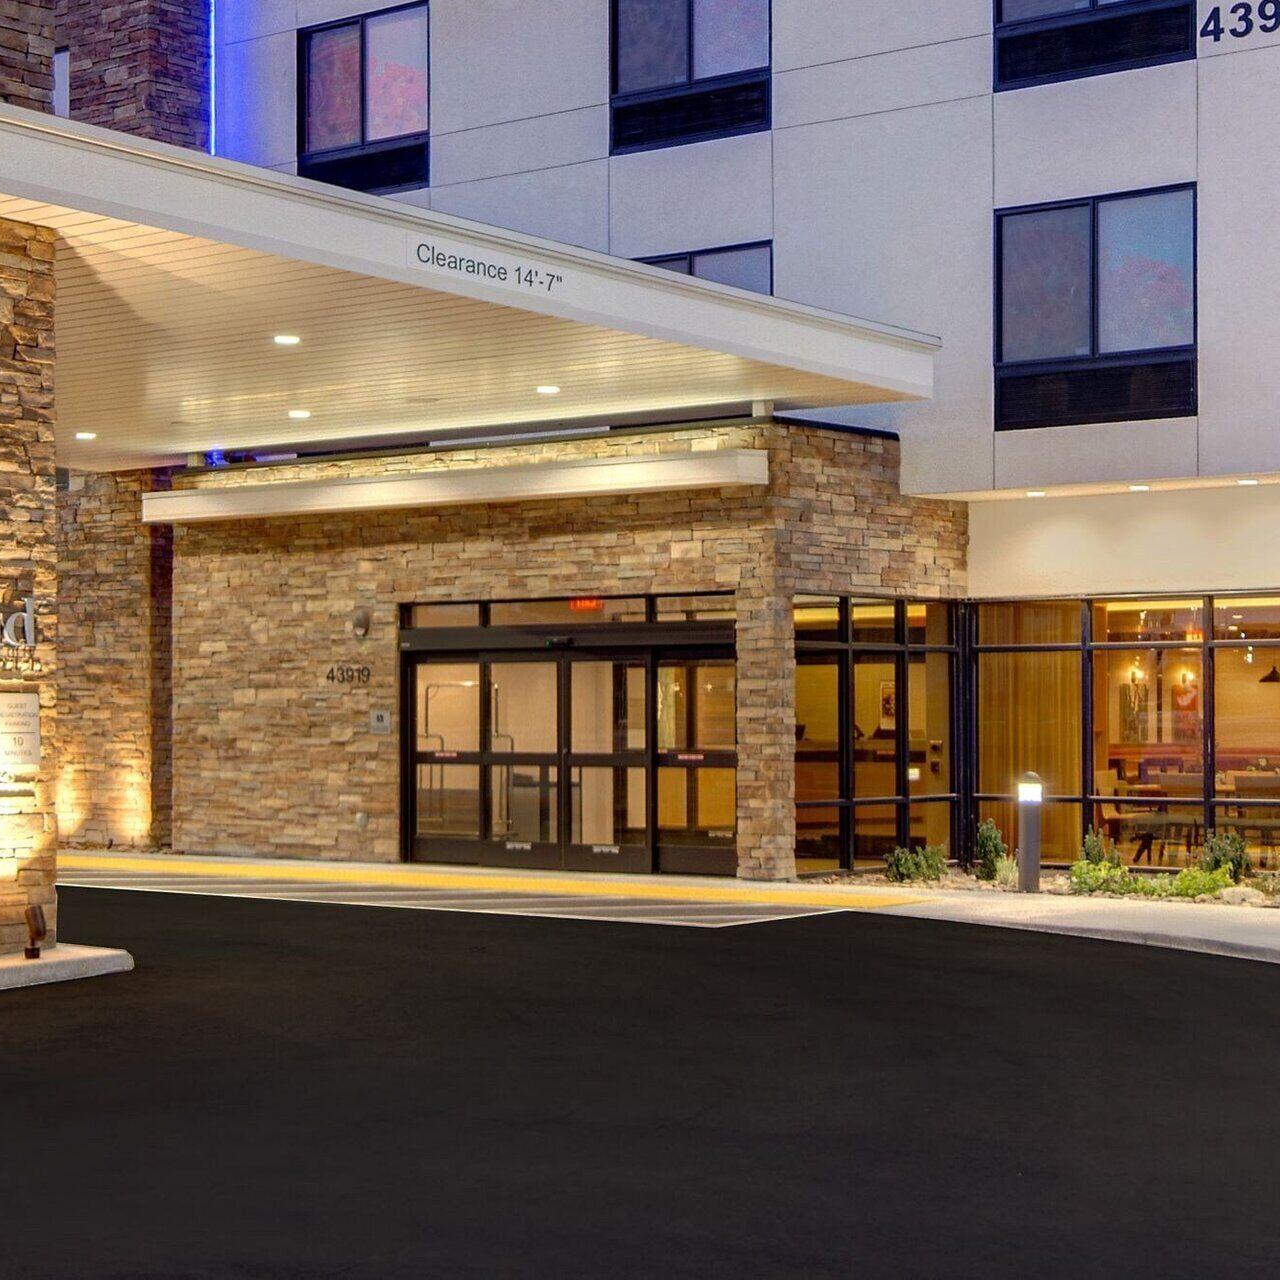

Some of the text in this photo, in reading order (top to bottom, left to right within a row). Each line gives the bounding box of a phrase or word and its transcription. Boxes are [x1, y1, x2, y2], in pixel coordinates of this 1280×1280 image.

[416, 243, 508, 281] Clearance
[326, 666, 371, 684] 43919
[13, 736, 24, 746] 10
